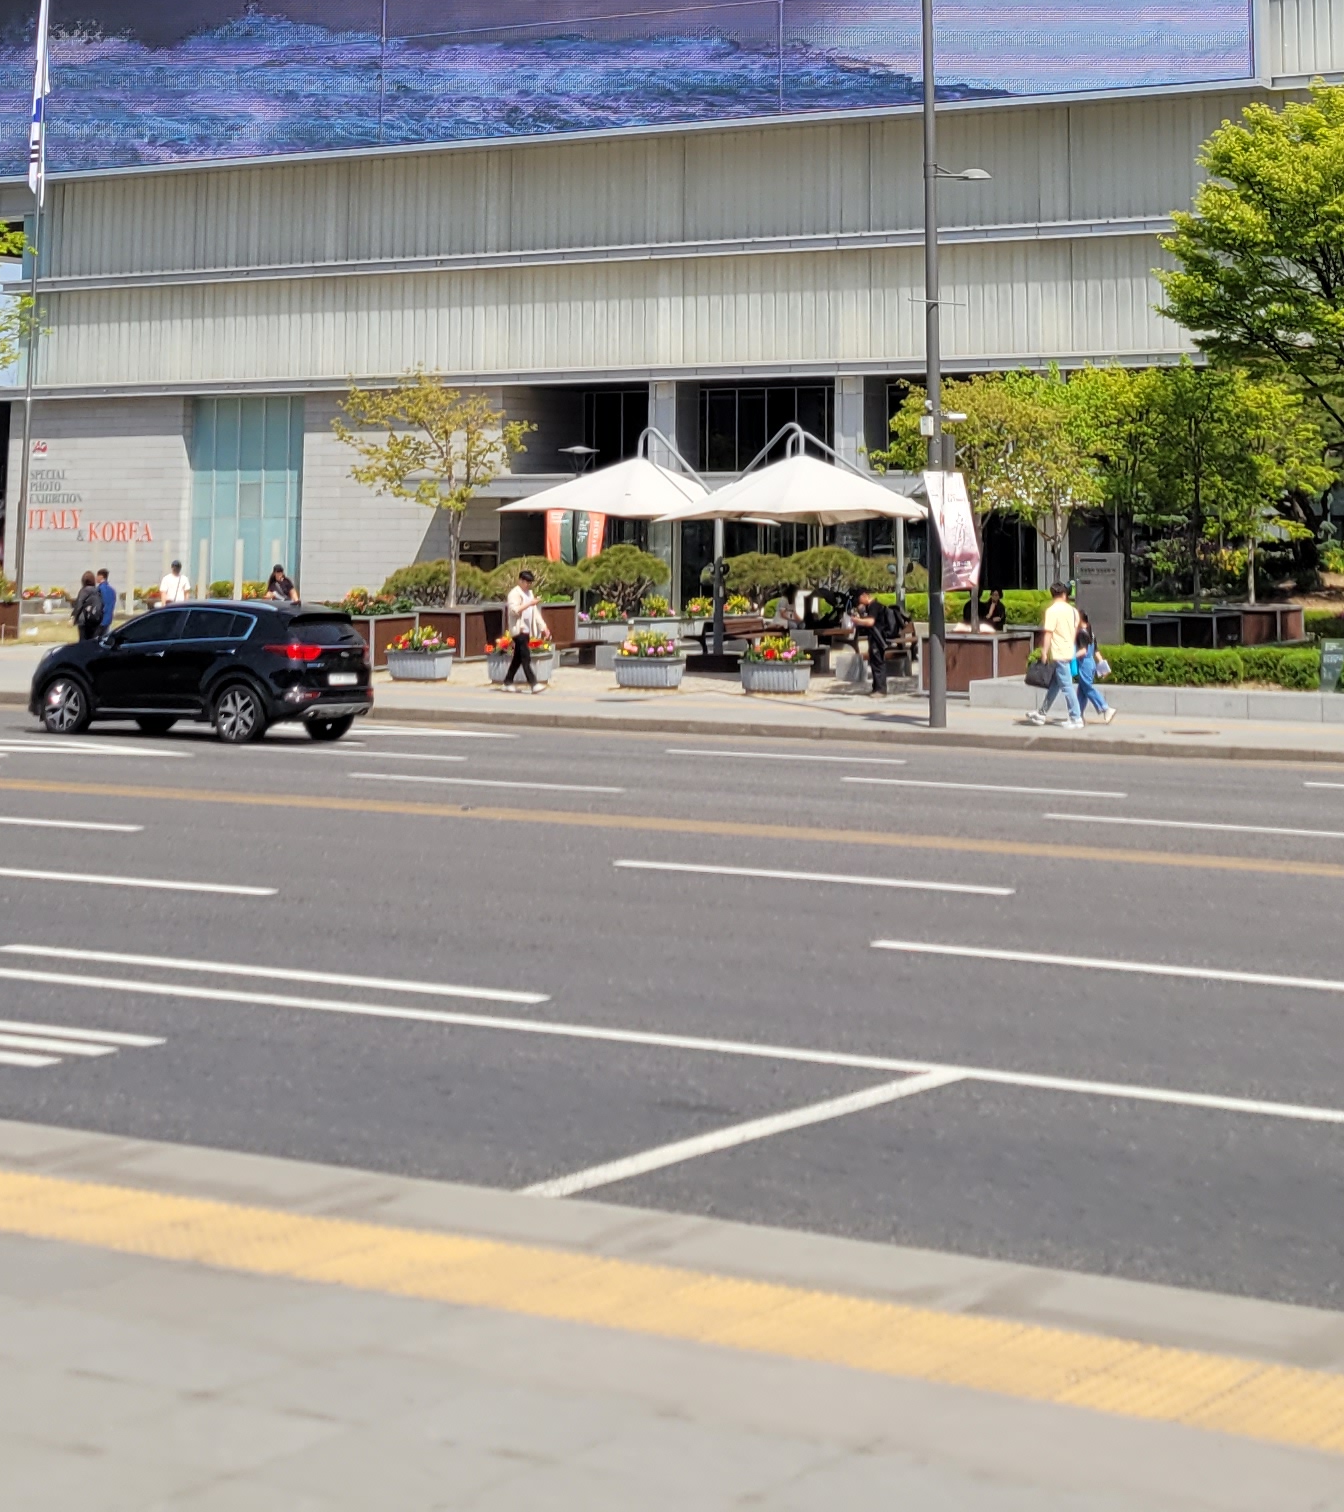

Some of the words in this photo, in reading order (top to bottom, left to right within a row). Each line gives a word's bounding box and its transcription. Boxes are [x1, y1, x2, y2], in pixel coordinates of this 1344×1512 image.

[30, 469, 66, 480] SPECIAL
[30, 481, 61, 492] PHOTO
[28, 509, 83, 530] ITALY
[76, 529, 85, 542] &
[88, 521, 152, 543] KOREA
